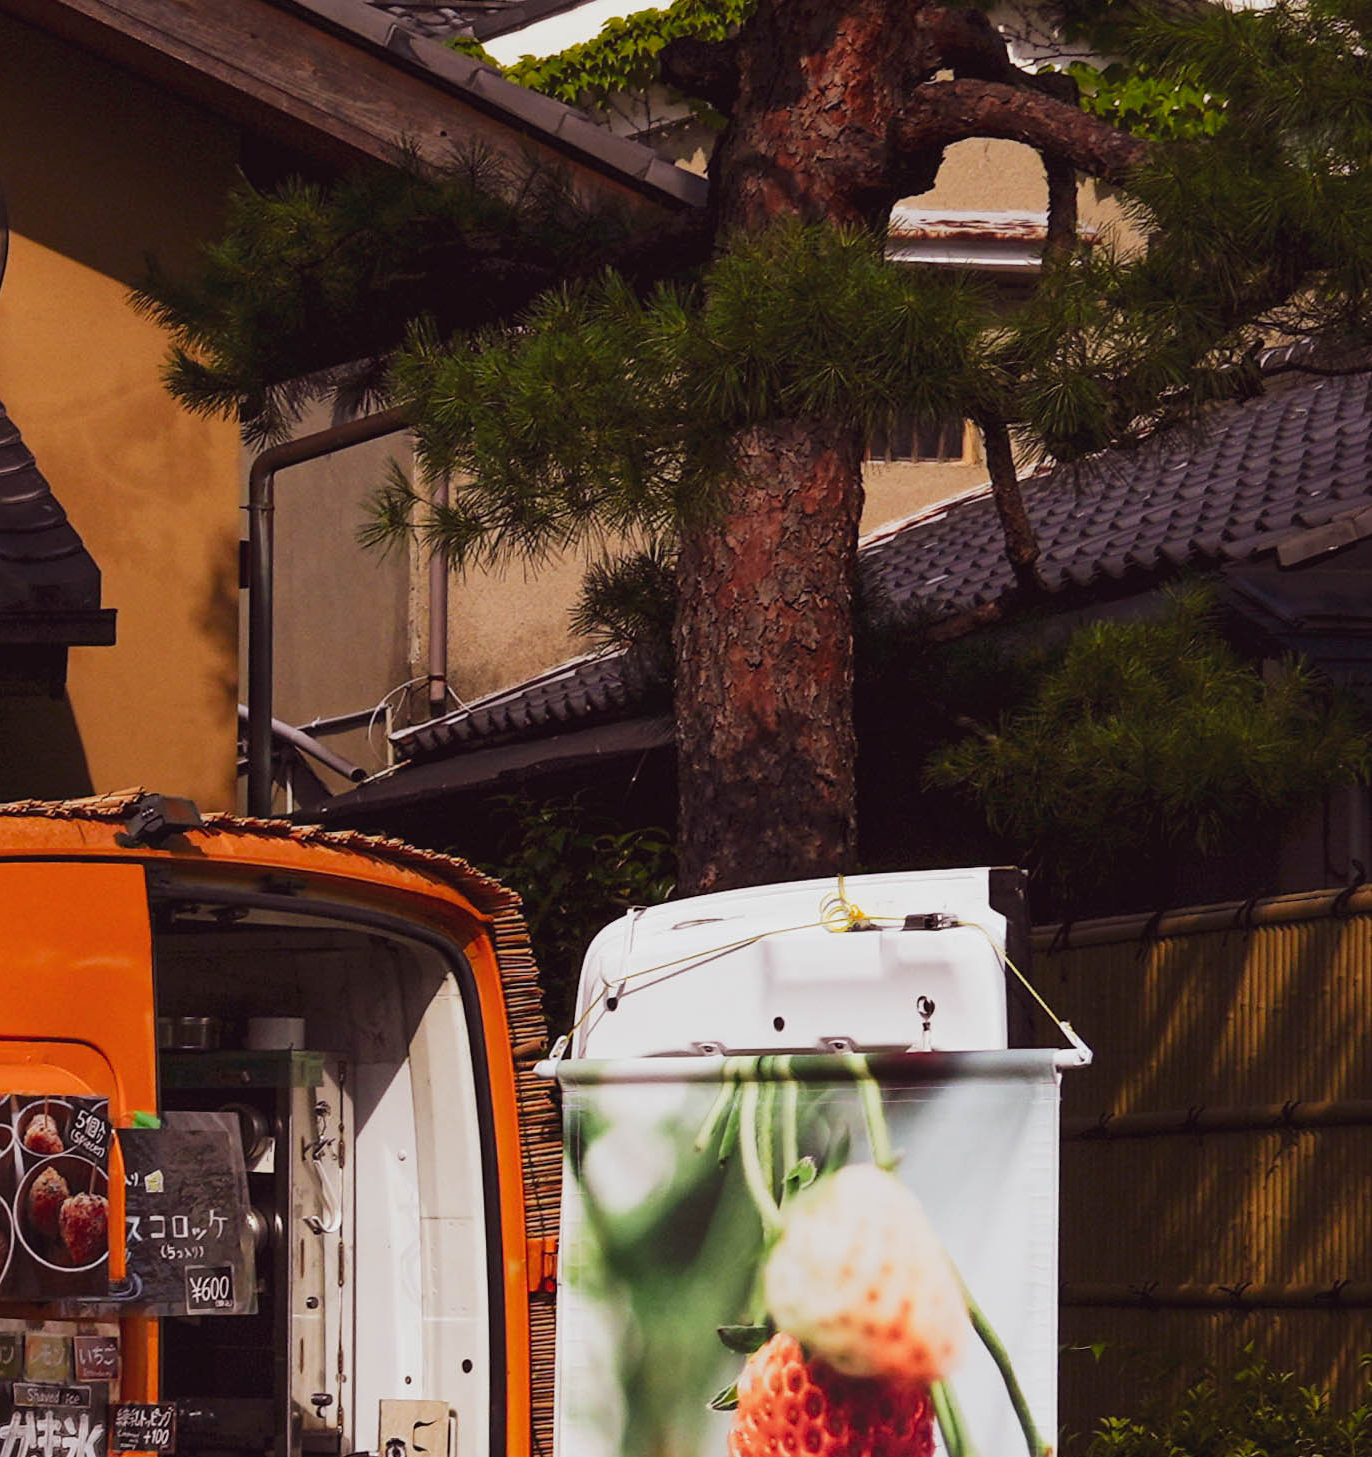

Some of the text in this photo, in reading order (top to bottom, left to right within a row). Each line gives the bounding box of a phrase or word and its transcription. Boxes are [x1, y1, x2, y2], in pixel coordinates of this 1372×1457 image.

[189, 1275, 231, 1304] ¥600
[79, 1345, 115, 1366] いちご
[26, 1388, 81, 1405] Shaved ice
[143, 1429, 170, 1446] +100
